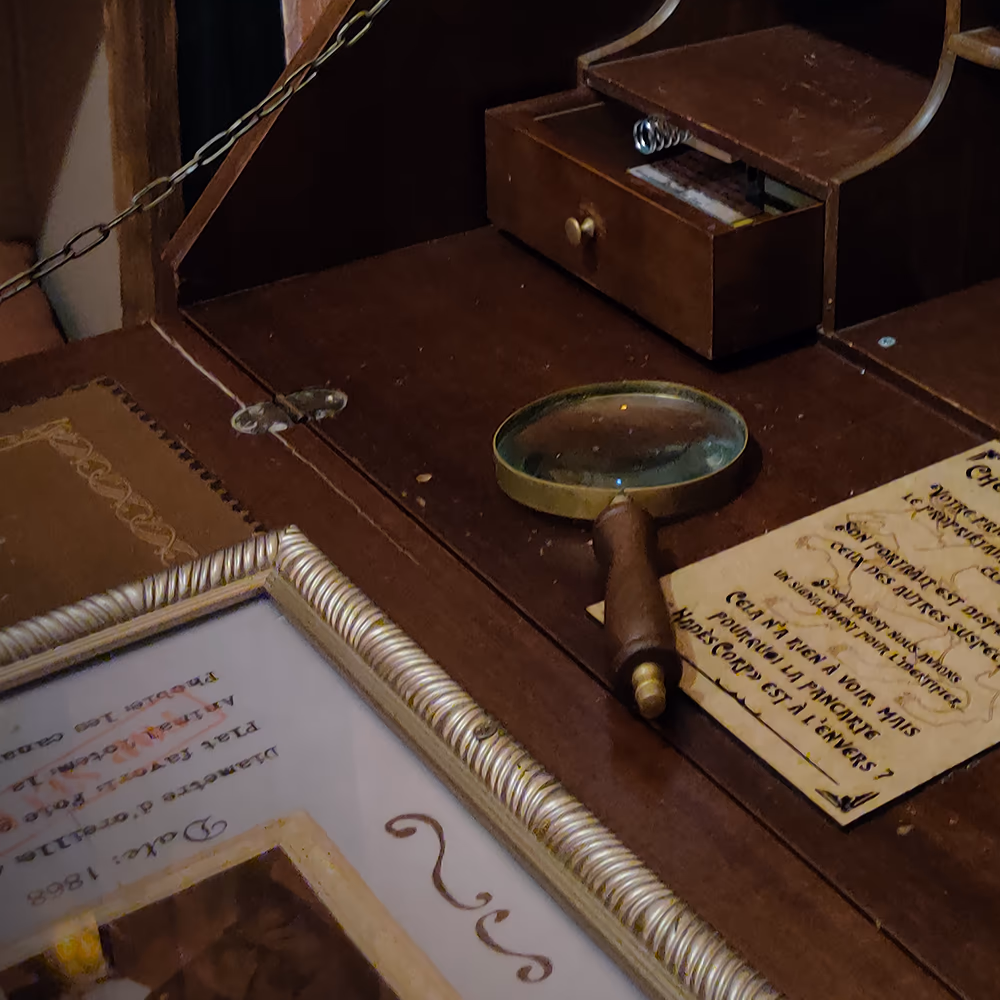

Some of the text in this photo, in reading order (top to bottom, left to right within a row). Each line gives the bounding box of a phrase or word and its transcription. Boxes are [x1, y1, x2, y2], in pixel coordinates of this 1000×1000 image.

[902, 493, 922, 505] LE
[929, 484, 976, 517] VOTRE
[830, 542, 869, 569] CEUX
[864, 565, 895, 585] DES
[893, 585, 950, 622] AUTRES
[835, 519, 872, 543] SON
[865, 542, 937, 590] PORTRAIT
[935, 587, 965, 606] EST
[774, 570, 793, 582] UN
[854, 631, 890, 656] POUR
[827, 586, 890, 632] SEULEMENT
[888, 631, 920, 653] NOUS
[707, 612, 880, 740] POURQUOI LA PANCARTE
[726, 591, 764, 621] CELA
[761, 618, 789, 640] N'A
[786, 637, 827, 665] RIEN
[822, 663, 840, 675] À
[877, 707, 920, 737] MAIS
[75, 711, 118, 733] les
[201, 720, 261, 754] Plat
[761, 683, 792, 705] EST
[787, 702, 807, 716] À
[801, 715, 877, 771] L'ENVERS
[874, 768, 894, 780] ?
[26, 815, 228, 907] Date: 1868
